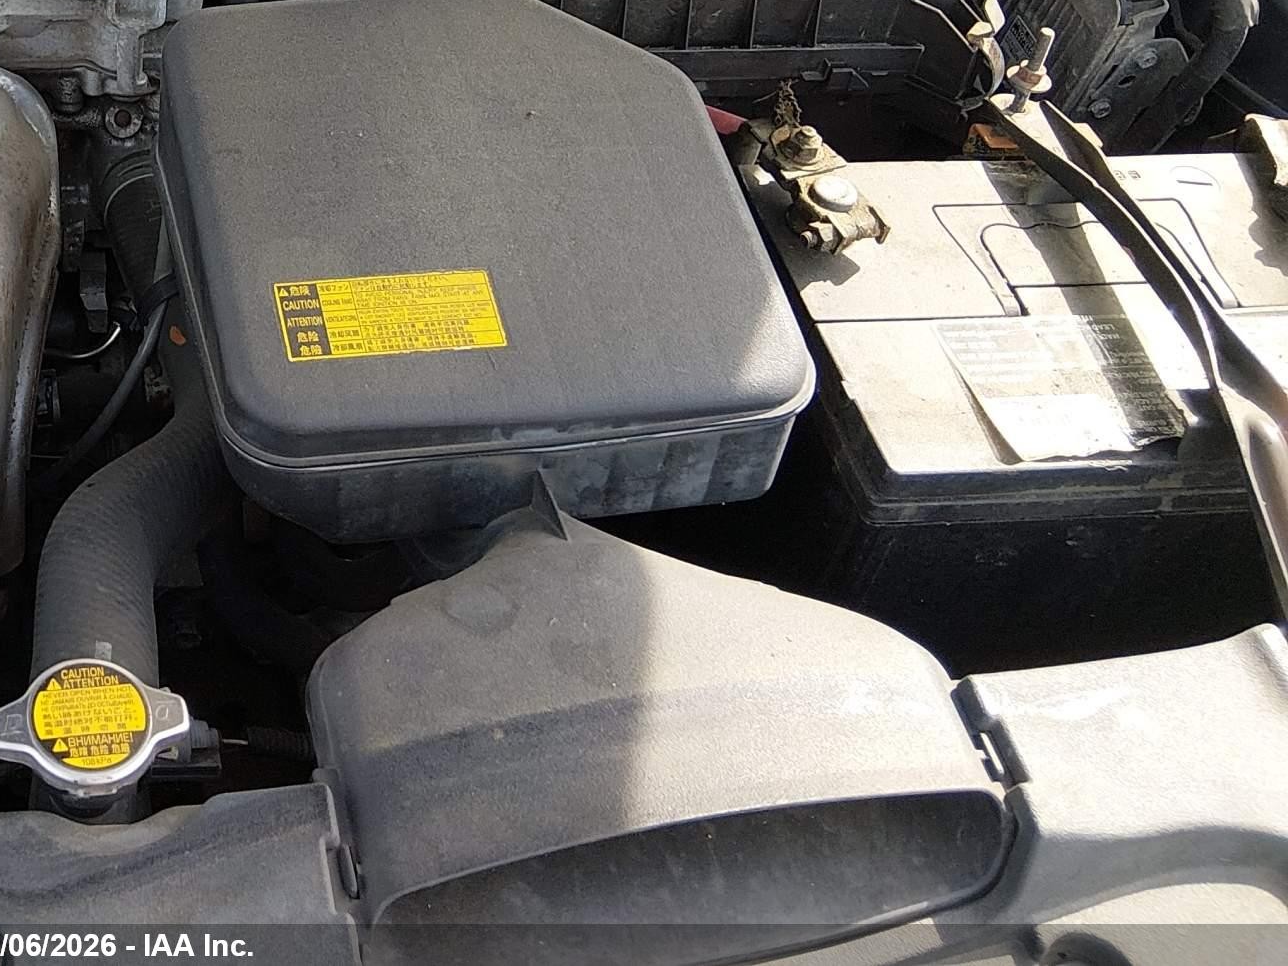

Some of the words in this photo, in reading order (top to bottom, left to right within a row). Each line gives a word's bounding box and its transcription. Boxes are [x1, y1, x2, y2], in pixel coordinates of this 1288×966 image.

[282, 299, 320, 311] CAUTION
[287, 316, 323, 328] ATTENTION
[60, 666, 105, 680] CAUTION
[63, 675, 119, 690] ATTENTION
[71, 689, 90, 697] OPEN
[67, 731, 133, 747] ВНИМАНИЕ!
